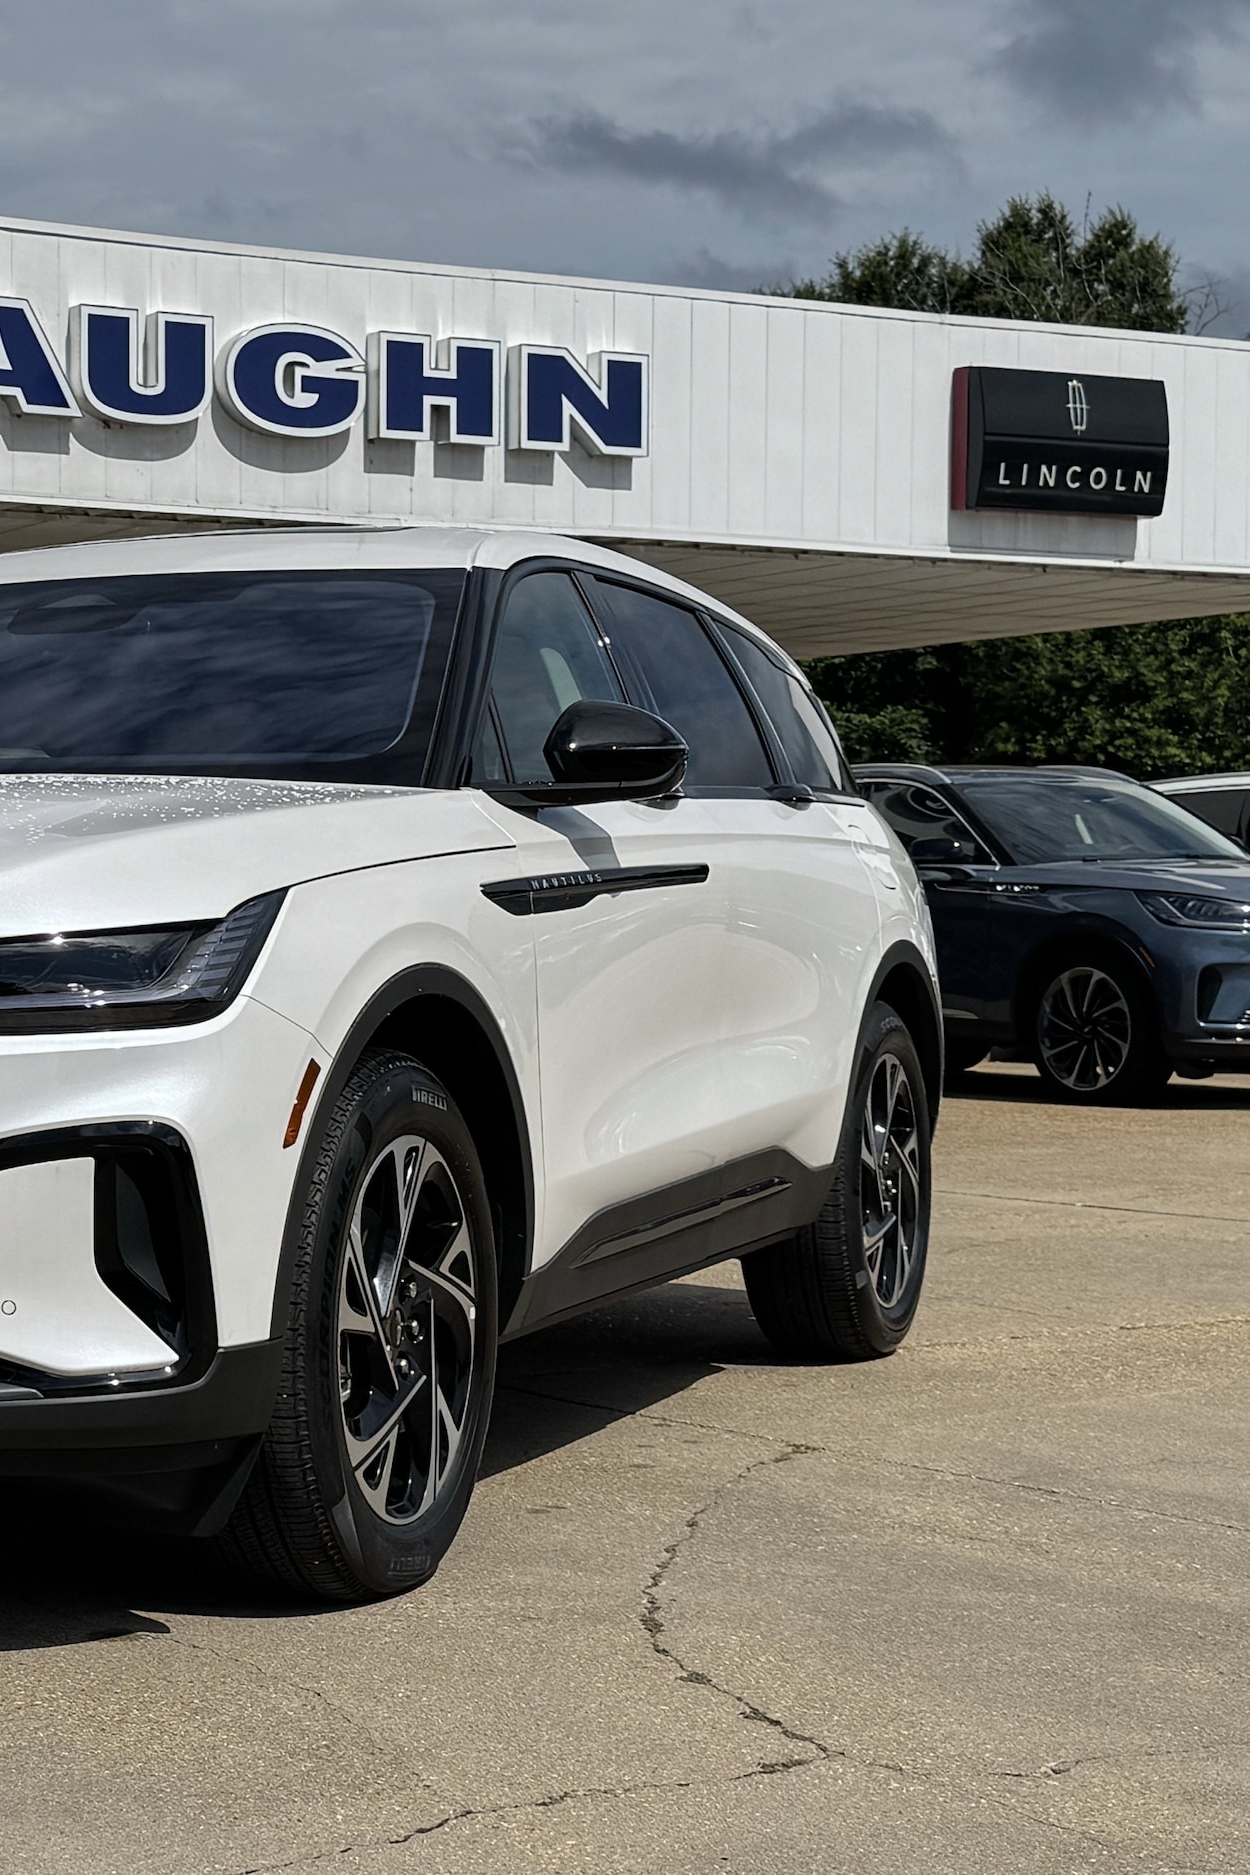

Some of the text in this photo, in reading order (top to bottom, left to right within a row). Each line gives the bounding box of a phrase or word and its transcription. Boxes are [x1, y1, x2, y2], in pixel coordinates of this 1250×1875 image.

[998, 462, 1152, 493] LINCOLN
[531, 873, 602, 890] NAUTILUS
[411, 1085, 447, 1111] PIRELLI
